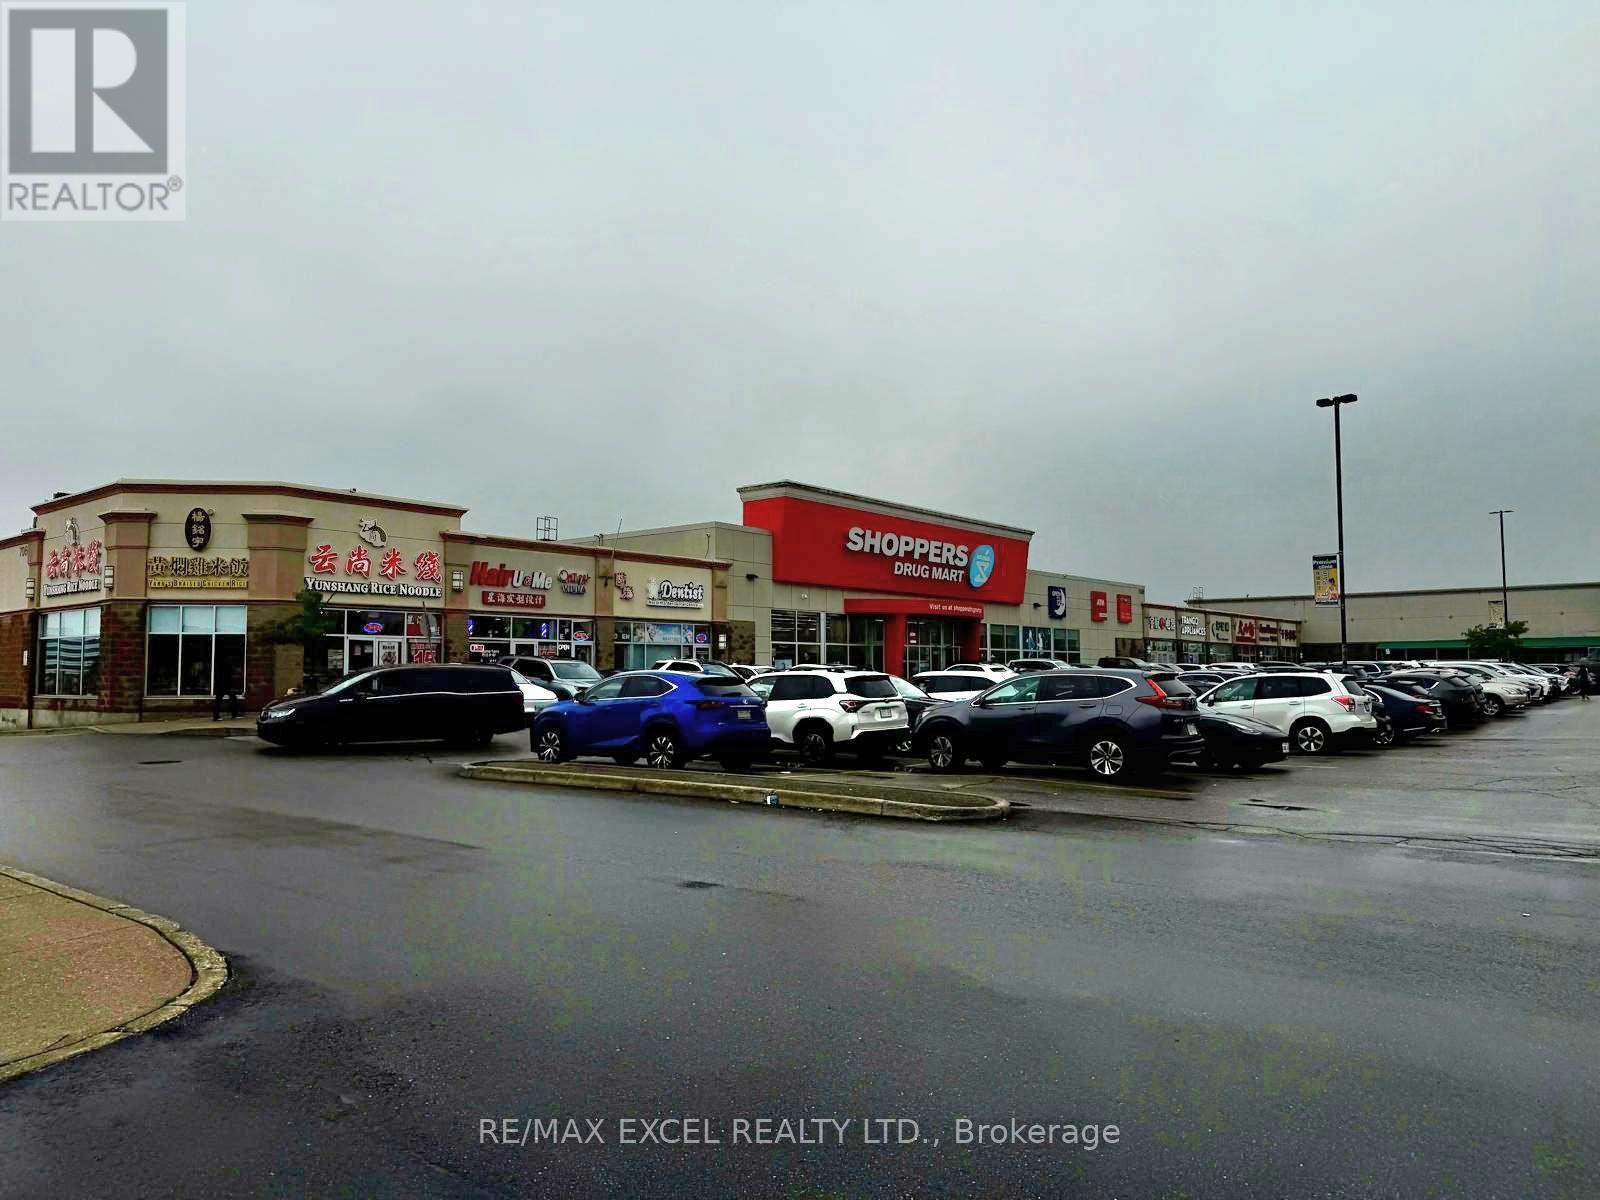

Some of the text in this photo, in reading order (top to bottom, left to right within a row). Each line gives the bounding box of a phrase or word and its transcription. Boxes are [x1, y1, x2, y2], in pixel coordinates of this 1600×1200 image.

[846, 526, 969, 567] SHOPPERS
[469, 560, 513, 587] Hair
[894, 561, 965, 583] DRUG MART
[660, 580, 703, 600] Dentist
